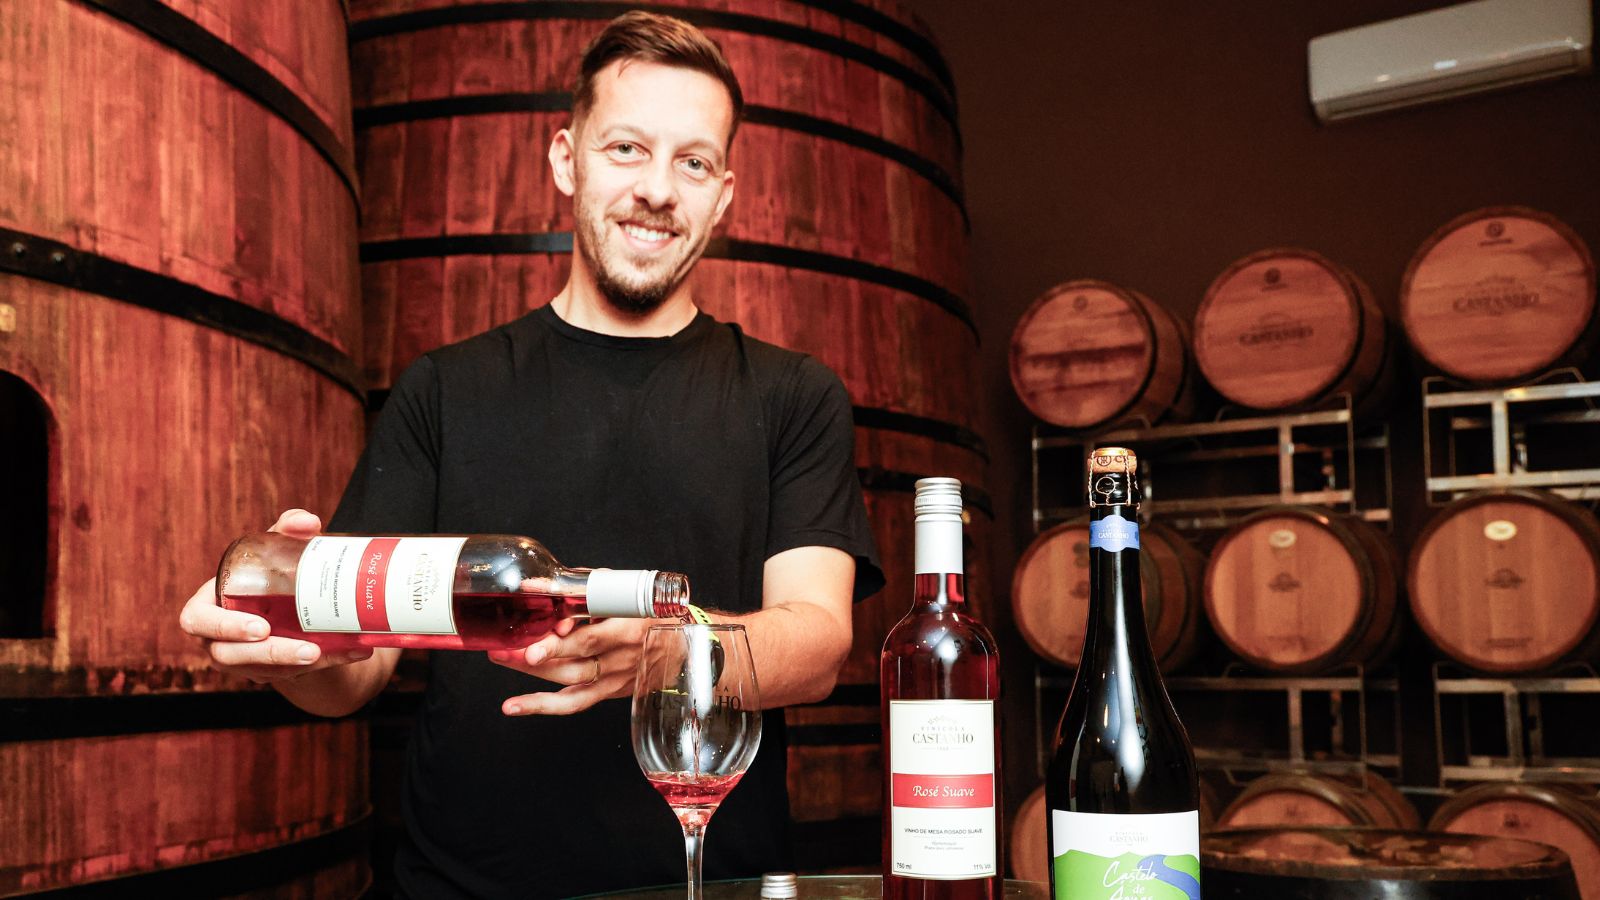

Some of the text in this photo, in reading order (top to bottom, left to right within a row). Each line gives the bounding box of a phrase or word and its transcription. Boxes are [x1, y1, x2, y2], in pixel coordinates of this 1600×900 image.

[366, 552, 382, 610] Rosé Suave
[912, 733, 974, 744] CASTANHO
[912, 785, 975, 797] Rosé Suave
[1103, 861, 1158, 888] Castelo
[1133, 883, 1145, 894] de
